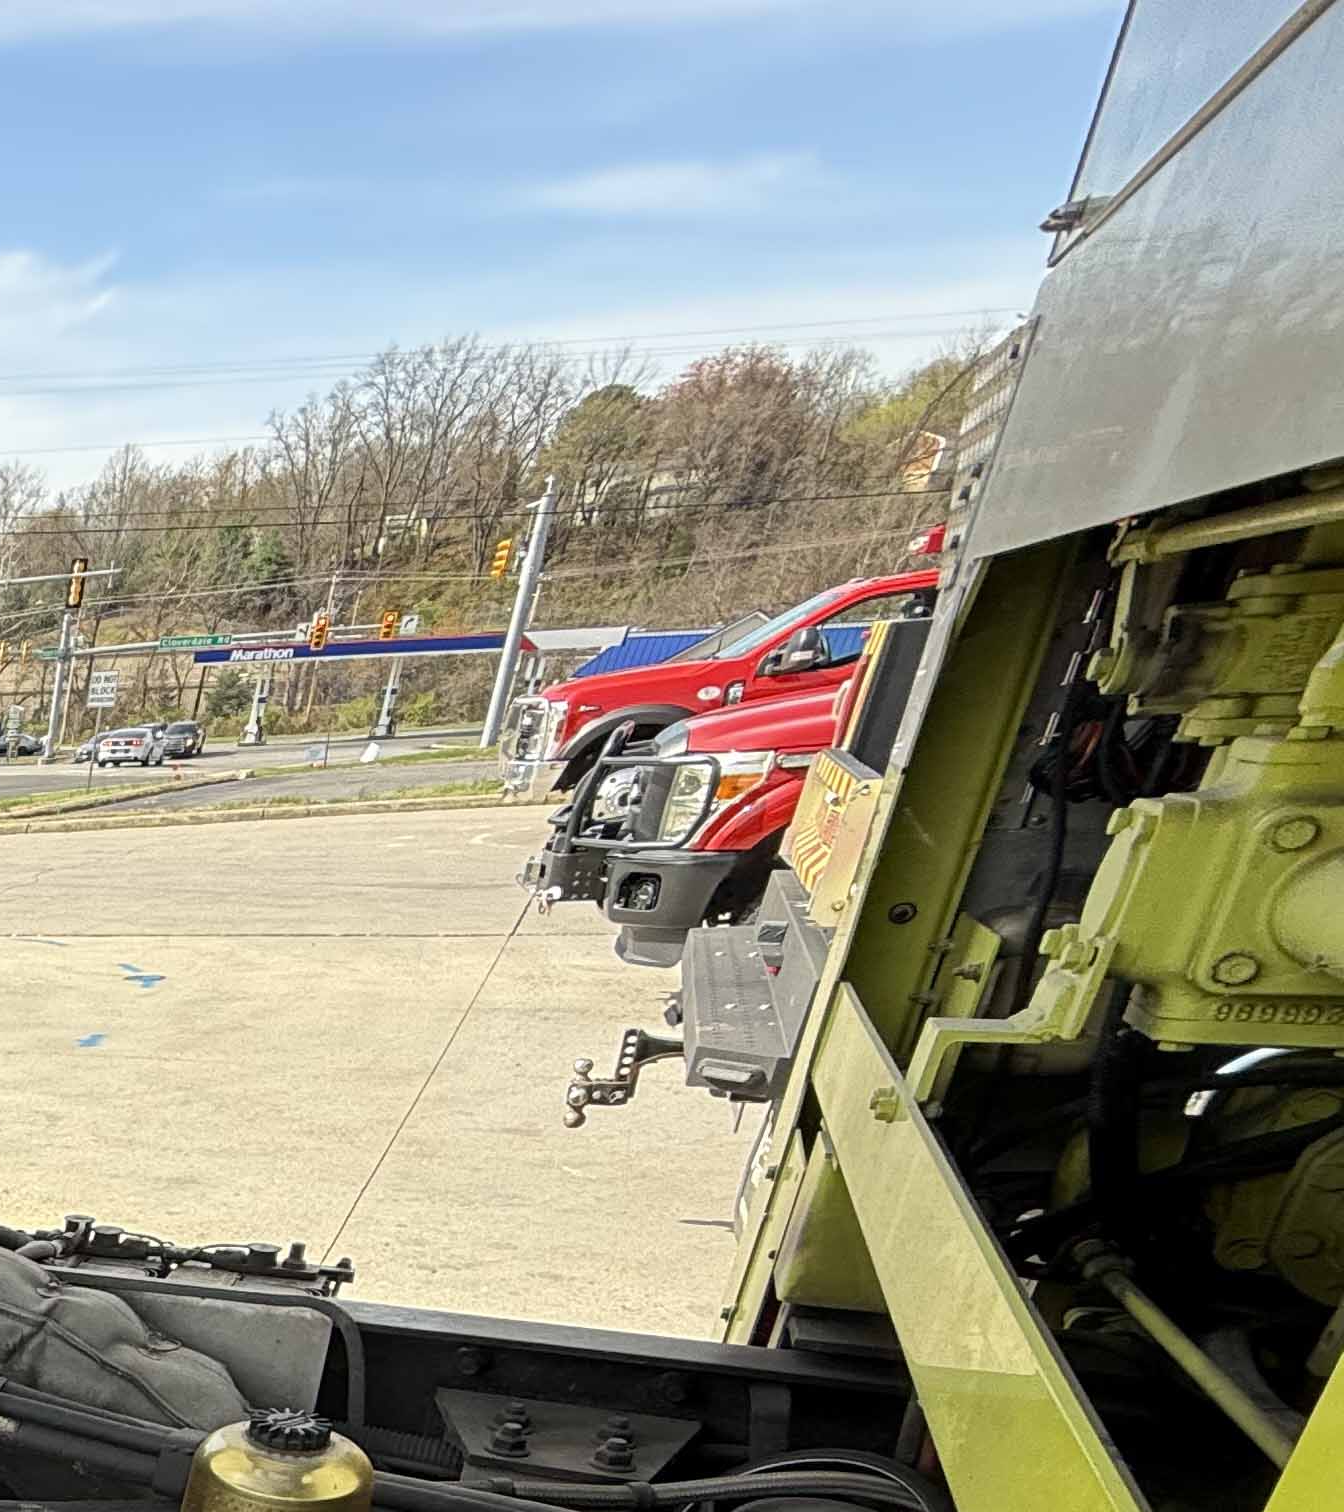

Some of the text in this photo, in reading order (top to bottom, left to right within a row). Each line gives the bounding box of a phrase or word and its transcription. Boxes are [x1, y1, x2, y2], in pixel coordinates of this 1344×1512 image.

[162, 636, 230, 648] Cloverdale Rd
[230, 647, 294, 661] Marathon
